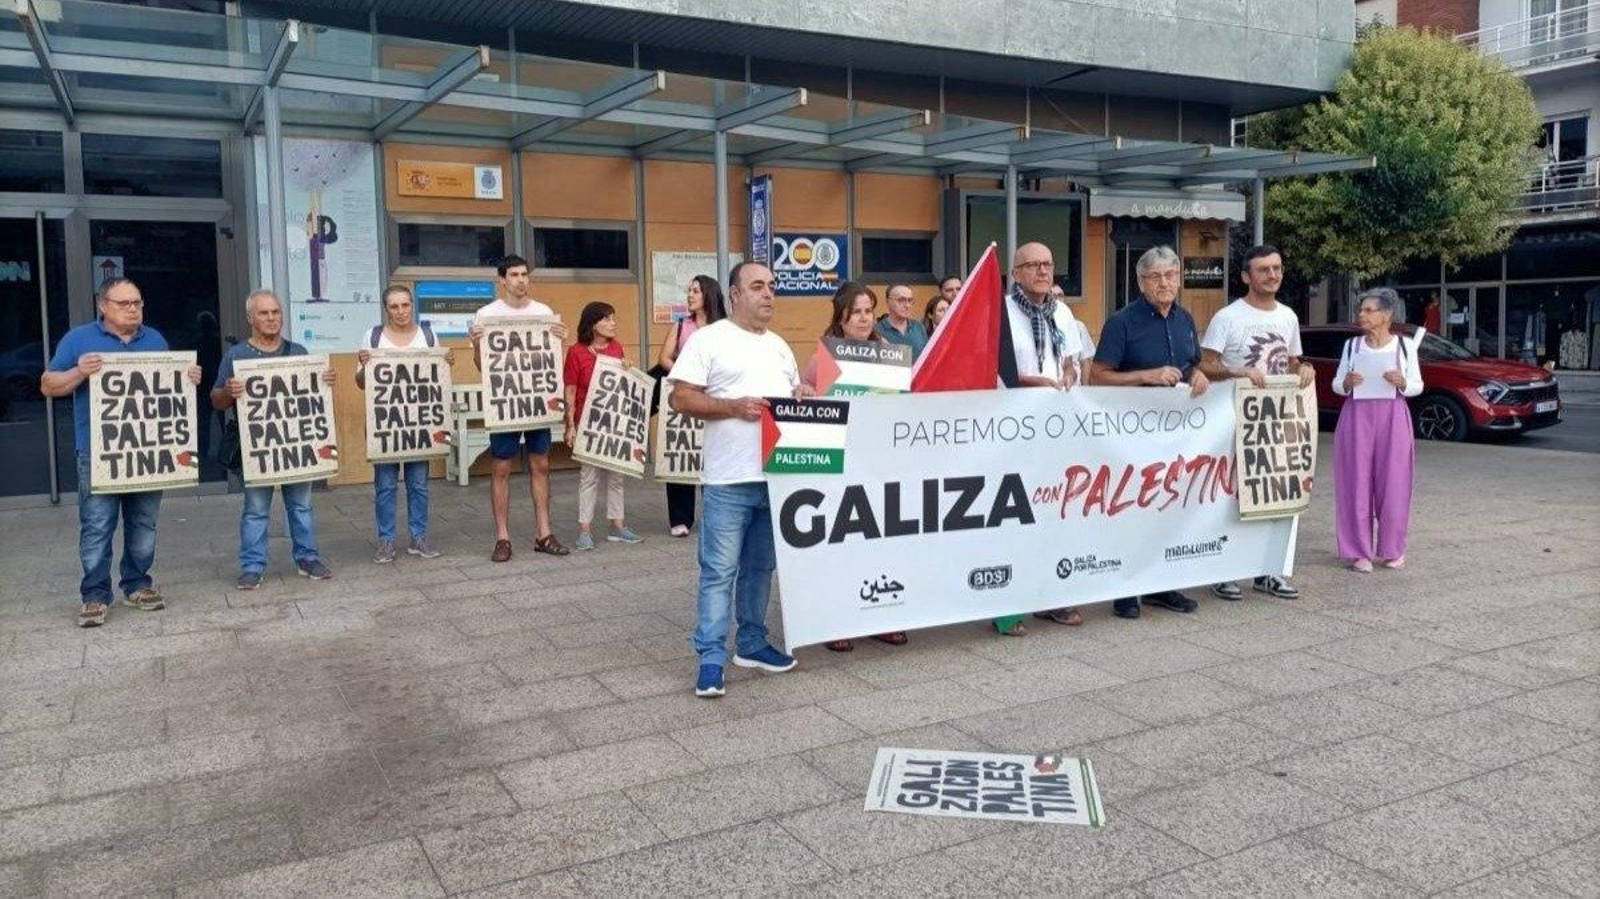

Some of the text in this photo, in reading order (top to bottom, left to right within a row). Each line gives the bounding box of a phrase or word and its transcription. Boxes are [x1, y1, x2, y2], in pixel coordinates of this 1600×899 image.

[488, 330, 551, 352] GALI
[836, 345, 904, 360] GALIZA CON
[374, 363, 439, 384] GALI
[489, 352, 555, 372] ZACON
[101, 370, 183, 396] GALI
[245, 372, 320, 399] GALI
[374, 385, 442, 404] ZACON
[490, 371, 558, 397] PALES
[598, 370, 646, 405] GALI
[101, 396, 187, 421] ZACON
[247, 396, 325, 421] ZACON
[374, 404, 445, 430] PALES
[490, 396, 547, 420] TINA
[591, 389, 646, 423] ZACON
[776, 404, 840, 418] GALIZA CON
[1243, 394, 1306, 421] GALI
[101, 419, 190, 451] PALES
[248, 416, 329, 449] PALES
[587, 407, 645, 444] PALES
[893, 406, 1206, 447] PAREMOS O XENOCIDIO
[1243, 421, 1311, 446] ZACON
[373, 429, 432, 453] TINA
[583, 430, 633, 461] TINA
[665, 430, 702, 451] PAL
[100, 449, 176, 479] TINA
[249, 444, 318, 474] TINA
[664, 452, 704, 472] TIN
[775, 453, 831, 465] PALESTINA
[1244, 443, 1312, 476] PALES
[1244, 474, 1301, 505] TINA
[779, 473, 1036, 549] GALIZA
[1033, 483, 1063, 505] CON
[1088, 560, 1122, 572] PALESTINA
[860, 573, 905, 602] جنين
[897, 759, 942, 808] GALI
[941, 759, 979, 813] ZACON
[981, 761, 1028, 814] PALES
[1029, 774, 1077, 817] TINA
